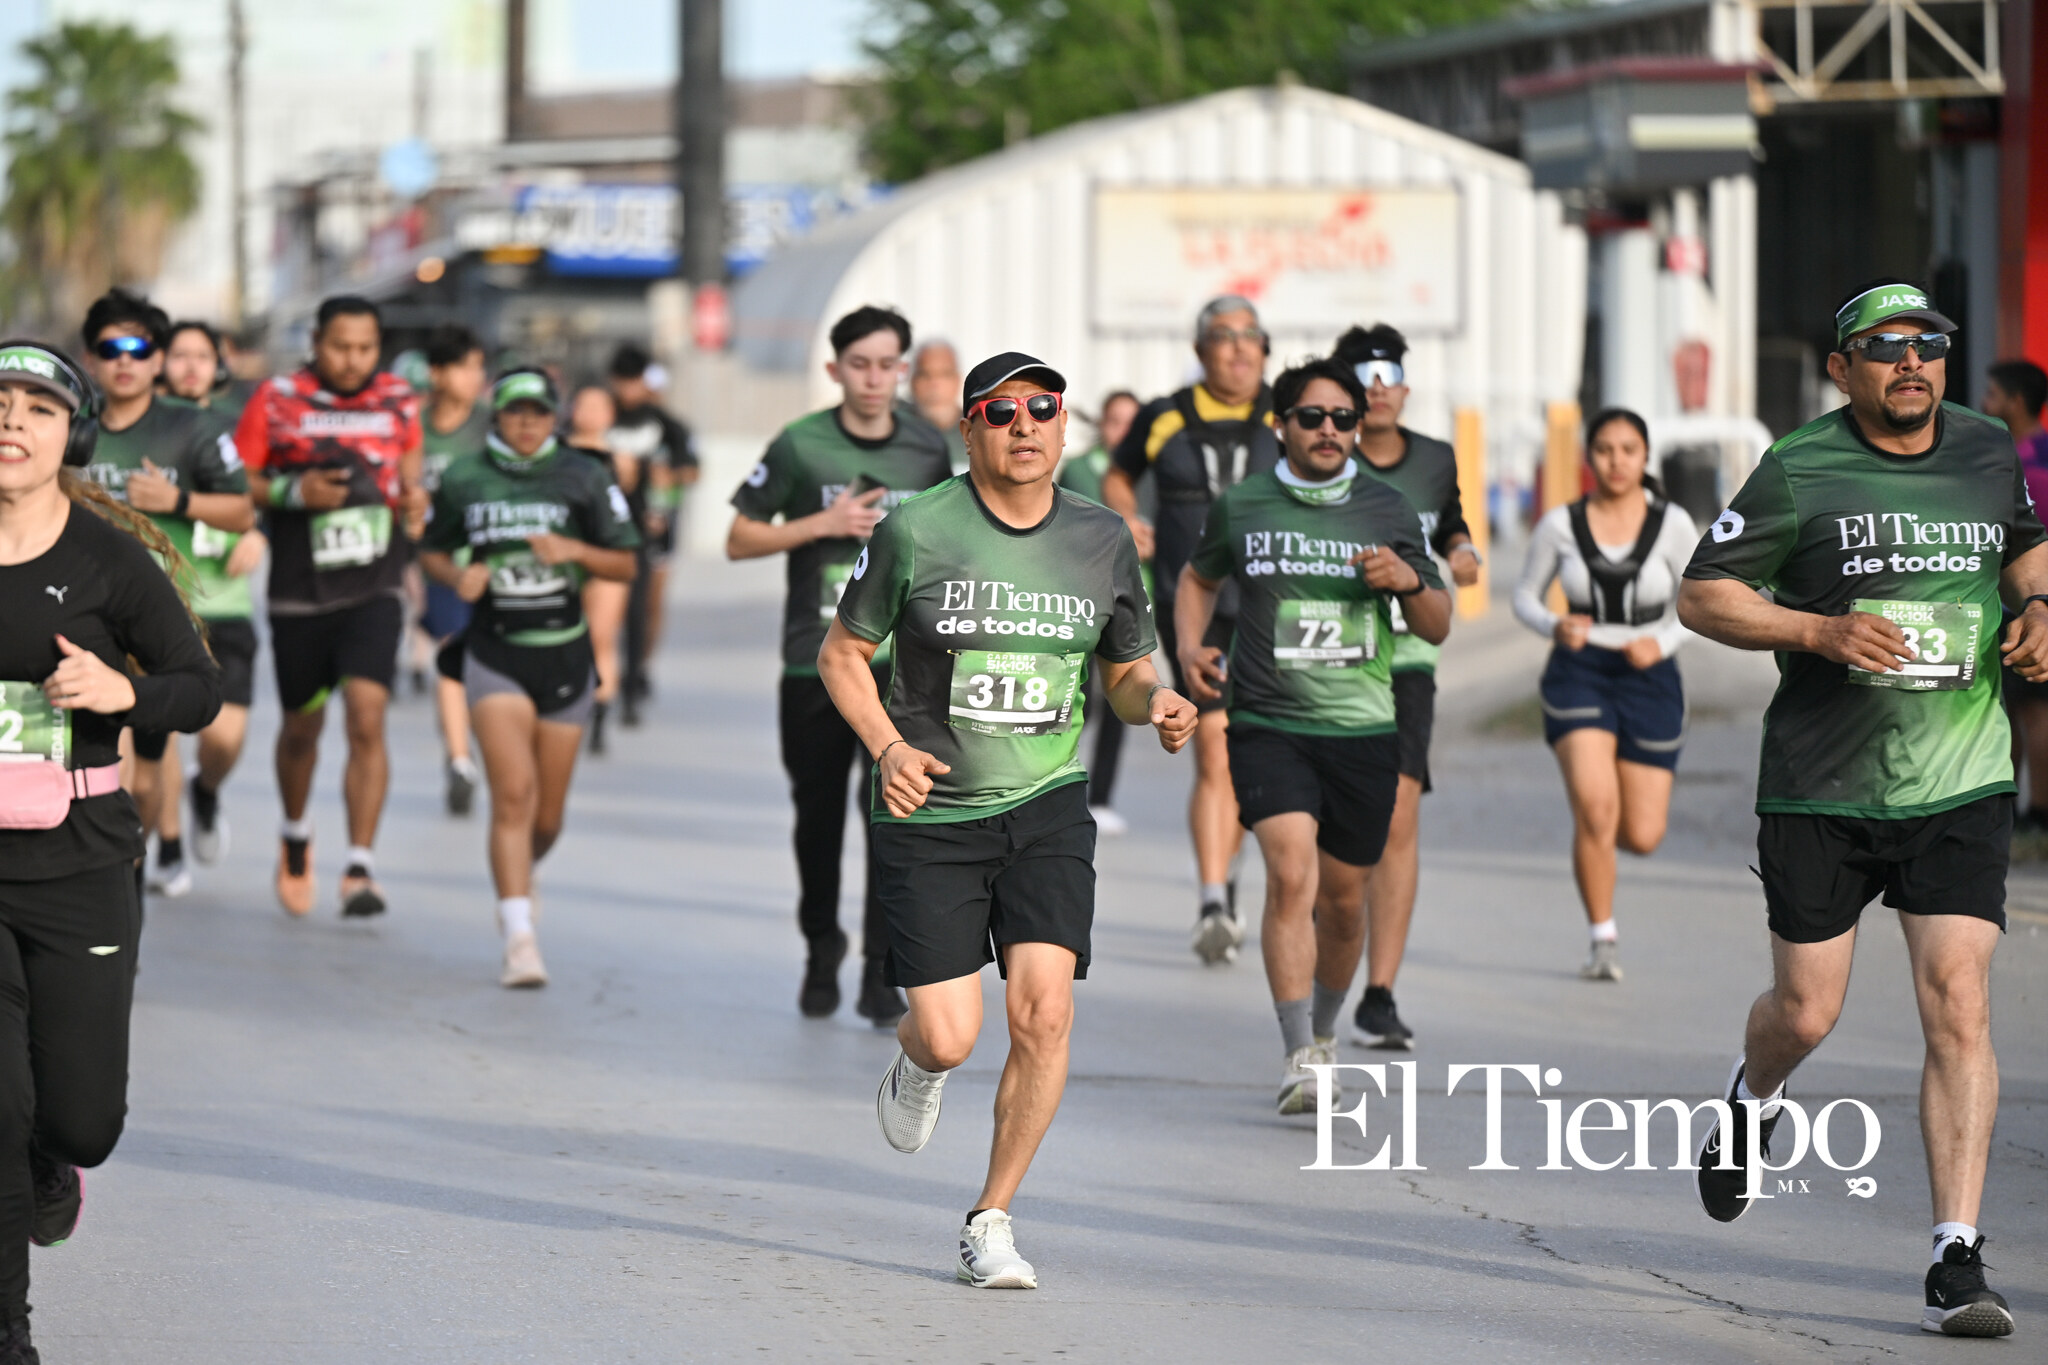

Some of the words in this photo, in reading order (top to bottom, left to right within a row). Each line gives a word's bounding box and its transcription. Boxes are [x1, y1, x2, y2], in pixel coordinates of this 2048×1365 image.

[1245, 531, 1271, 557] El
[1275, 531, 1373, 560] Tiemp
[1834, 513, 1879, 550] El
[1882, 513, 2004, 552] Tiempo
[1246, 559, 1276, 576] de
[1278, 558, 1356, 579] todos
[1842, 555, 1884, 576] de
[1889, 551, 1981, 572] todos
[939, 580, 975, 611] El
[981, 581, 1095, 623] Tiempo
[1882, 603, 1934, 611] CARRERA
[1967, 610, 1980, 618] 133
[935, 616, 977, 635] de
[981, 616, 1074, 640] todos
[1298, 620, 1342, 648] 72
[987, 653, 1036, 662] CARRERA
[1962, 624, 1979, 680] MEDALLA
[967, 674, 1048, 711] 318
[1058, 671, 1077, 722] MEDALLA
